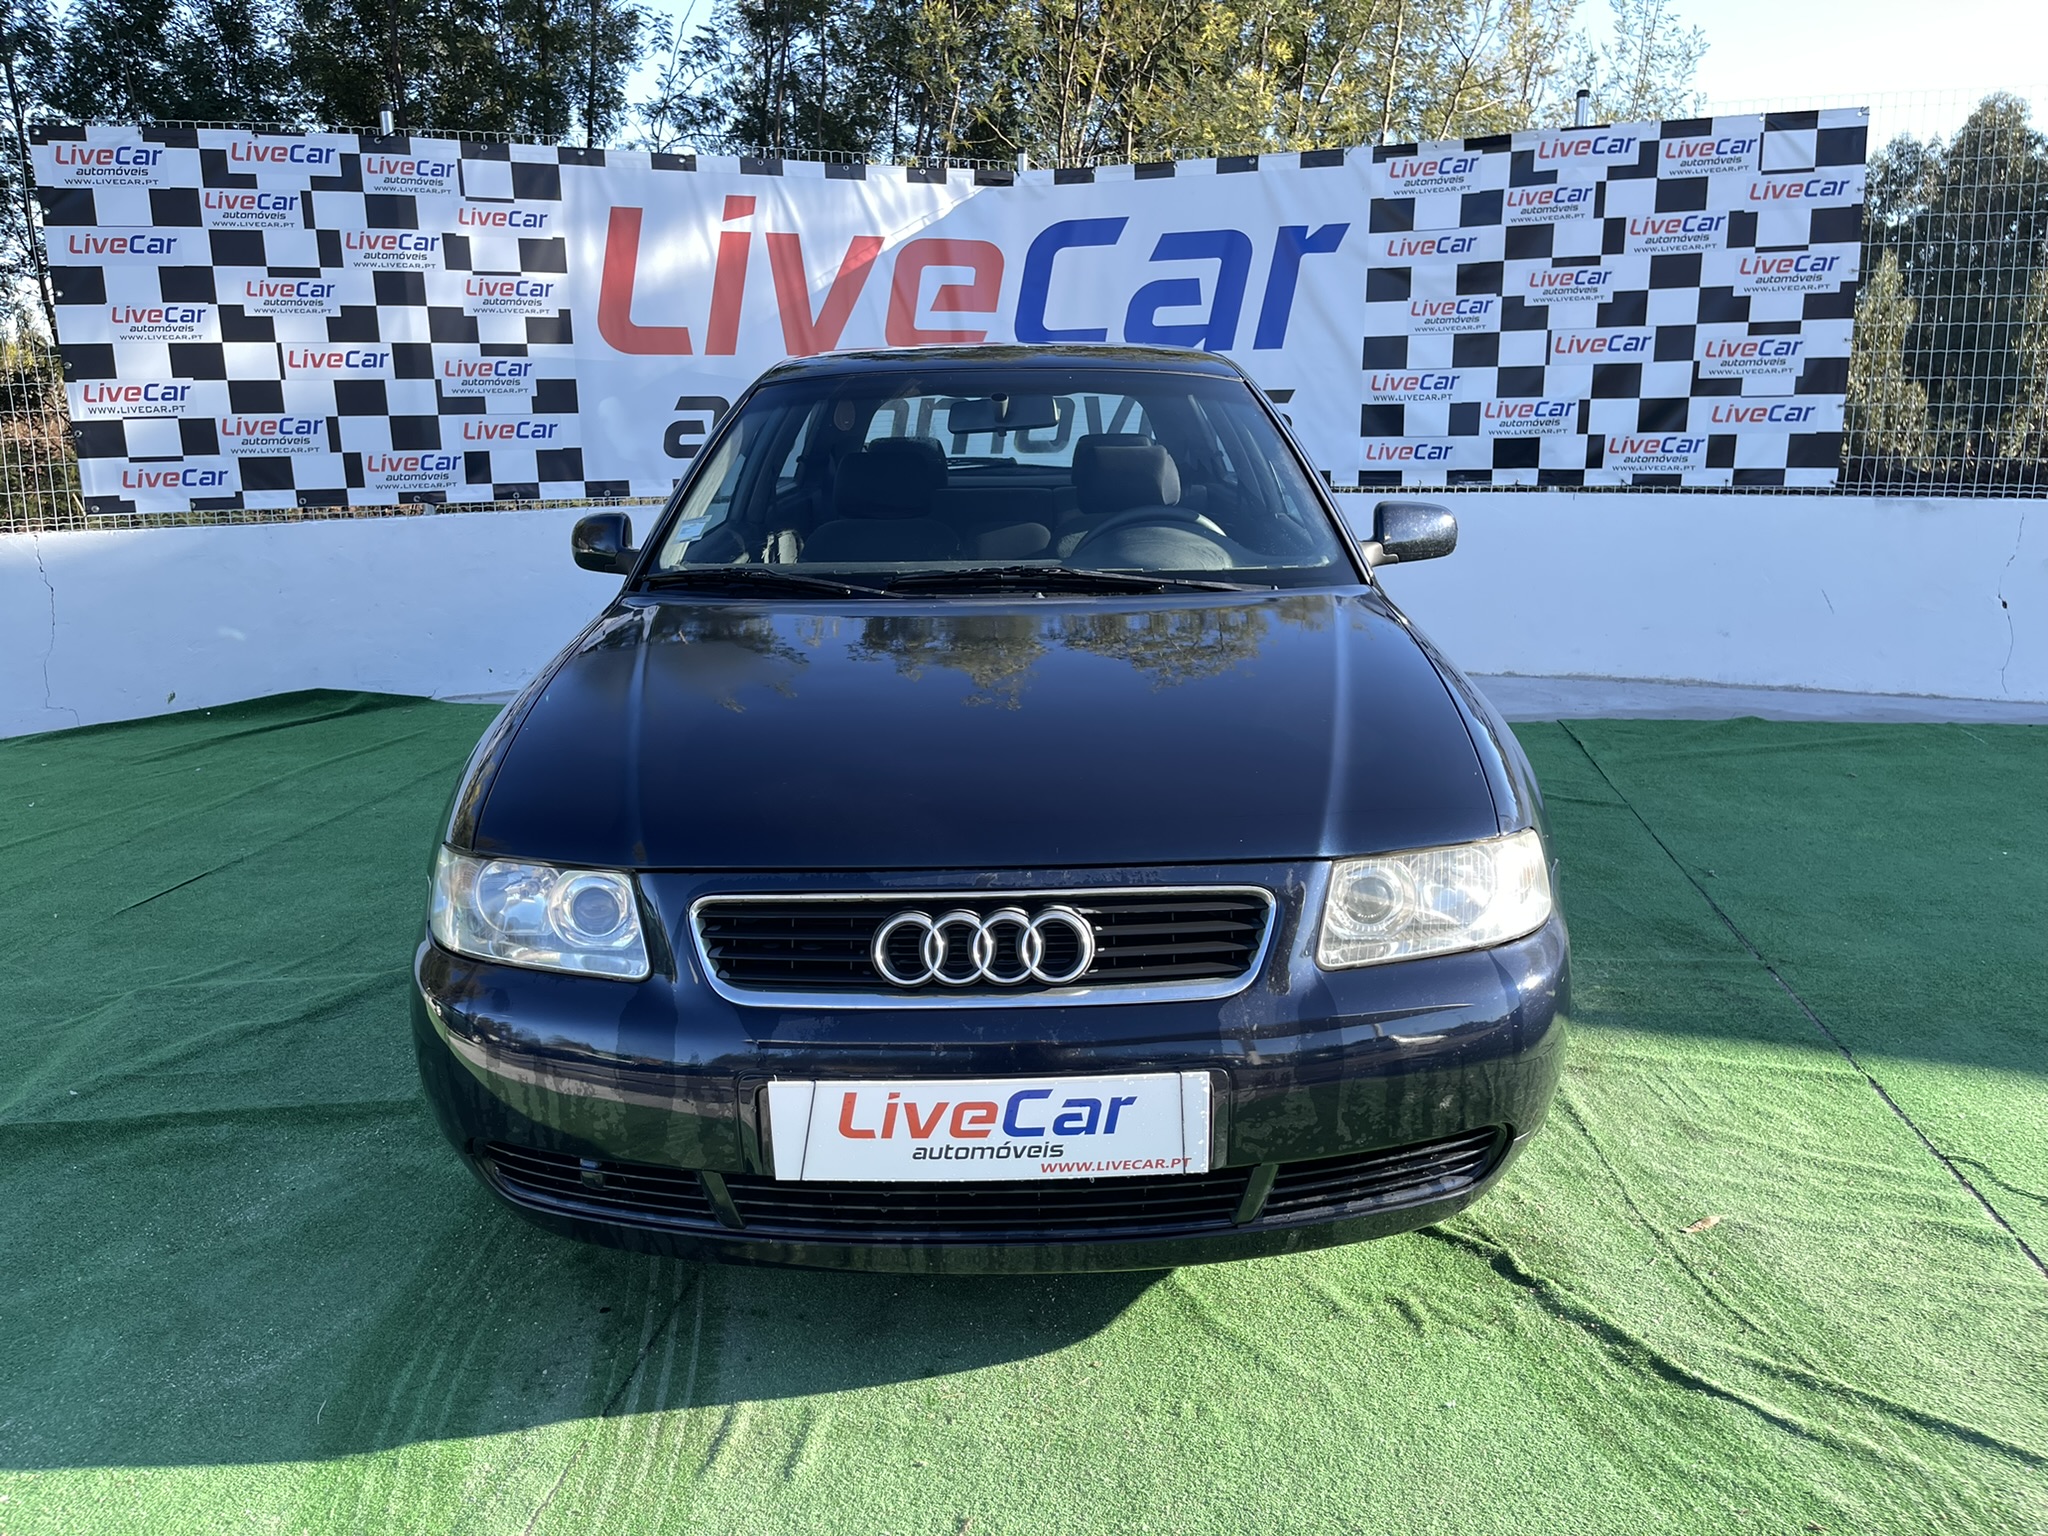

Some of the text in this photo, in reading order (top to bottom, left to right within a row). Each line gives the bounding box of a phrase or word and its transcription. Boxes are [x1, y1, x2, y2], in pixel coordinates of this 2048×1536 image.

[55, 144, 163, 166] LiveCar
[231, 141, 335, 164] LiveCar
[1538, 136, 1637, 159] LiveCar
[1665, 138, 1758, 159] LiveCar
[366, 156, 455, 177] LiveCar
[1389, 157, 1479, 179] LiveCar
[1680, 155, 1742, 166] automóveis
[76, 166, 149, 176] automóveis
[1668, 165, 1749, 176] WWW.LIVECAR.PT
[64, 178, 159, 186] WWW.LIVECAR.PT
[373, 185, 452, 194] WWW.LIVECAR.PT
[383, 176, 444, 187] automóveis
[1403, 175, 1465, 187] automóveis
[1749, 179, 1850, 200] LiveCar
[1393, 185, 1472, 195] WWW.LIVECAR.PT
[1507, 186, 1593, 207] LiveCar
[204, 191, 299, 211] LiveCar
[1520, 204, 1578, 215] automóveis
[222, 210, 286, 220] automóveis
[458, 208, 548, 228] LiveCar
[1510, 213, 1585, 223] WWW.LIVECAR.PT
[1630, 215, 1726, 235] LiveCar
[68, 233, 178, 254] LiveCar
[345, 231, 440, 252] LiveCar
[1387, 236, 1477, 257] LiveCar
[1644, 234, 1710, 244] automóveis
[363, 251, 427, 261] automóveis
[1633, 243, 1718, 253] WWW.LIVECAR.PT
[353, 261, 436, 269] WWW.LIVECAR.PT
[1739, 255, 1840, 275] LiveCar
[597, 195, 1350, 356] LiveCar
[1529, 270, 1612, 288] LiveCar
[1755, 273, 1823, 283] automóveis
[246, 280, 335, 298] LiveCar
[465, 278, 554, 298] LiveCar
[1542, 287, 1598, 295] automóveis
[1743, 283, 1831, 293] WWW.LIVECAR.PT
[263, 298, 324, 306] automóveis
[482, 298, 542, 307] automóveis
[1410, 299, 1494, 316] LiveCar
[1533, 295, 1605, 303] WWW.LIVECAR.PT
[111, 305, 206, 324] LiveCar
[1424, 315, 1480, 325] automóveis
[129, 324, 194, 333] automóveis
[1414, 324, 1486, 332] WWW.LIVECAR.PT
[1555, 334, 1652, 354] LiveCar
[1705, 339, 1803, 358] LiveCar
[288, 350, 389, 369] LiveCar
[444, 359, 533, 377] LiveCar
[1720, 358, 1786, 367] automóveis
[1708, 367, 1794, 376] WWW.LIVECAR.PT
[461, 378, 520, 386] automóveis
[1371, 374, 1461, 391] LiveCar
[83, 383, 191, 403] LiveCar
[1373, 393, 1453, 401] WWW.LIVECAR.PT
[88, 405, 186, 415] WWW.LIVECAR.PT
[1484, 401, 1576, 419] LiveCar
[1711, 404, 1816, 424] LiveCar
[222, 417, 324, 436] LiveCar
[463, 420, 558, 440] LiveCar
[1499, 418, 1560, 428] automóveis
[241, 436, 310, 446] automóveis
[1609, 436, 1706, 454] LiveCar
[230, 446, 320, 454] WWW.LIVECAR.PT
[1366, 444, 1454, 460] LiveCar
[367, 454, 461, 472] LiveCar
[1623, 454, 1688, 464] automóveis
[122, 468, 229, 489] LiveCar
[375, 481, 457, 490] WWW.LIVECAR.PT
[385, 472, 449, 482] automóveis
[838, 1088, 1138, 1139] LiveCar
[912, 1141, 1064, 1160] automóveis
[1040, 1157, 1192, 1174] WWW.LIVECAR.PT
